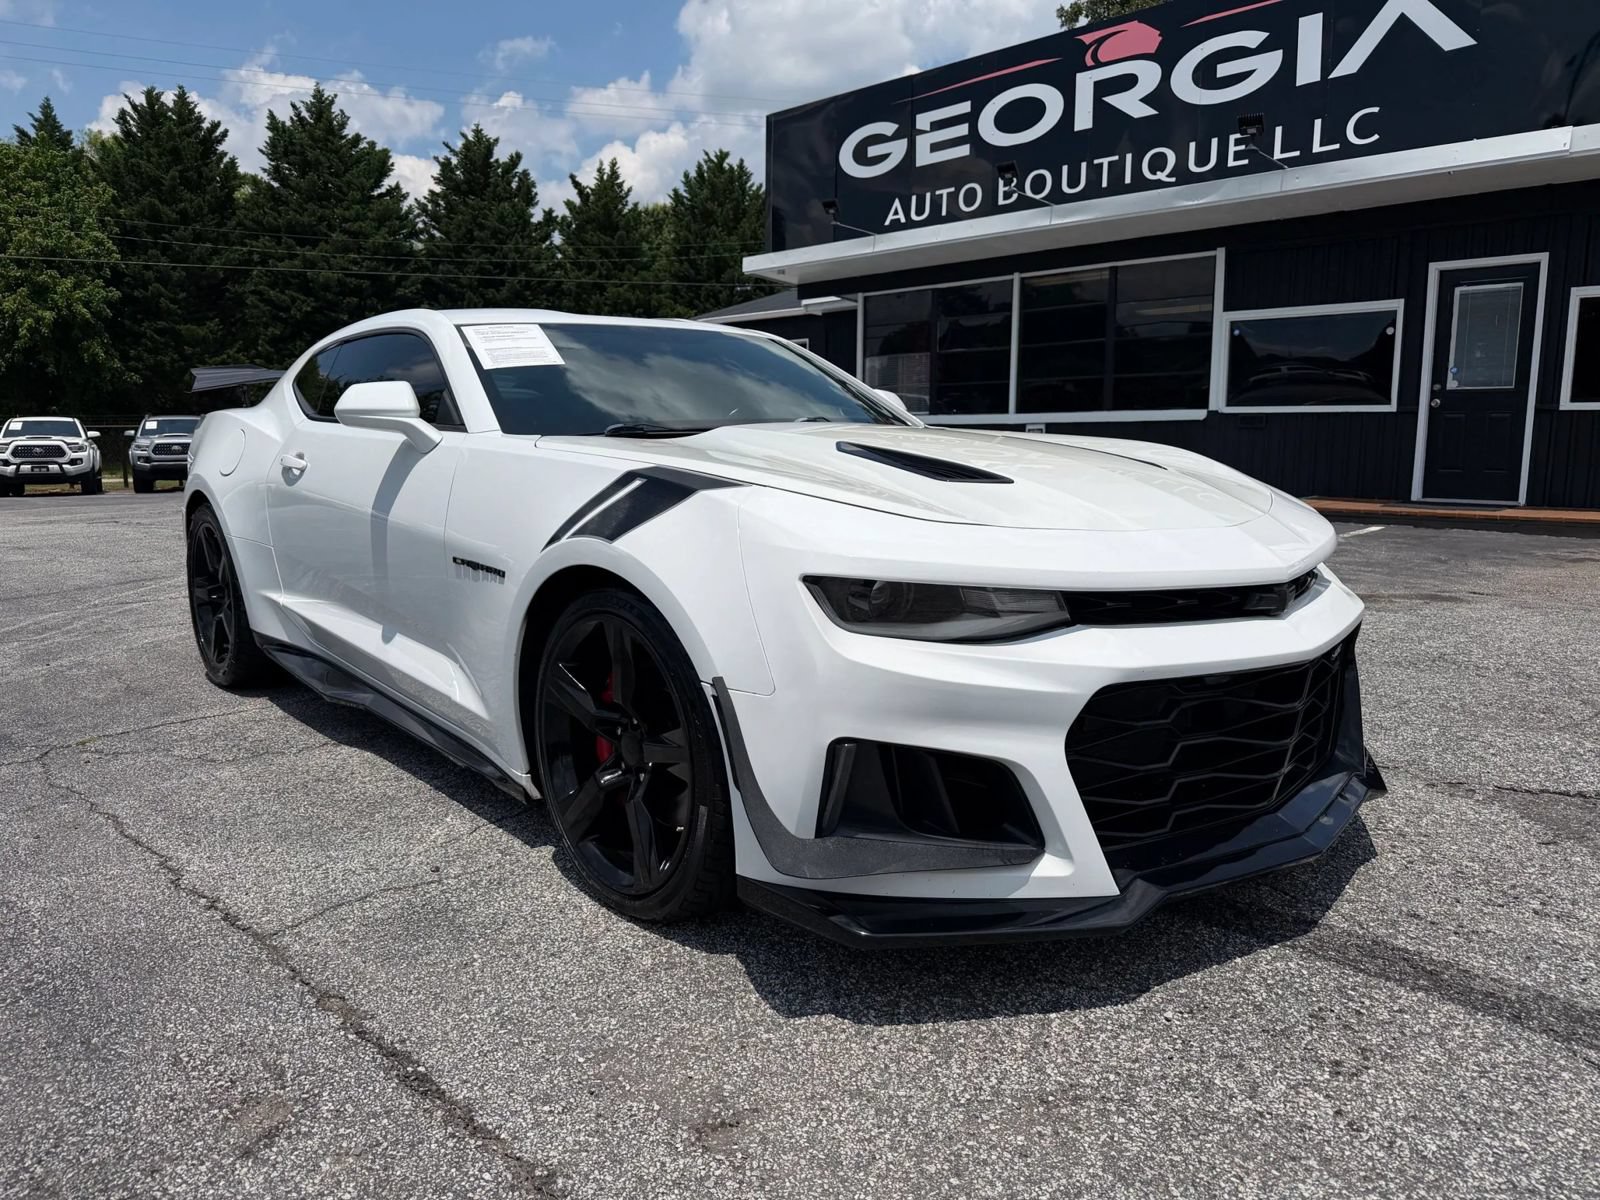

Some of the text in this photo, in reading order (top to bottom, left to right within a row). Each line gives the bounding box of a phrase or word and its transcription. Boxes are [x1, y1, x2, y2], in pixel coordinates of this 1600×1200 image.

[839, 0, 1477, 178] GEORGIA
[884, 106, 1380, 226] AUTO BOUTIQUE LLC
